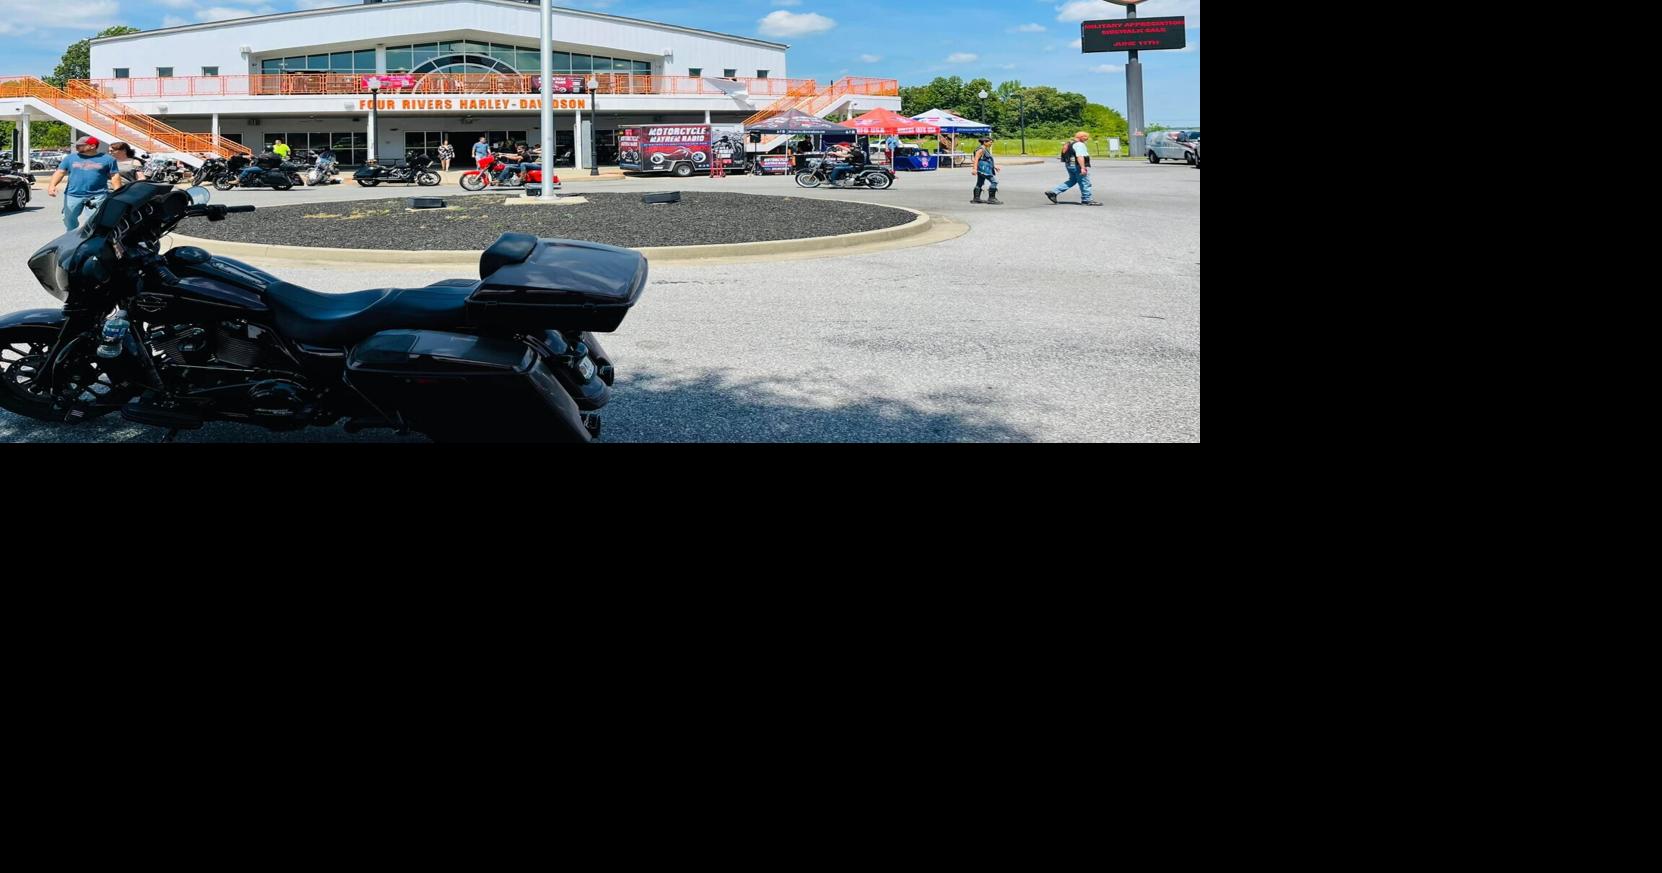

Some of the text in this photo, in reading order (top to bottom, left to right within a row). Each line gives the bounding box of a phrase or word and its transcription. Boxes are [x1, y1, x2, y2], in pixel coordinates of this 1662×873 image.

[359, 98, 585, 110] FOUR RIVERS HARLEY-DAVDSON
[648, 127, 706, 136] MOTORCYCLE
